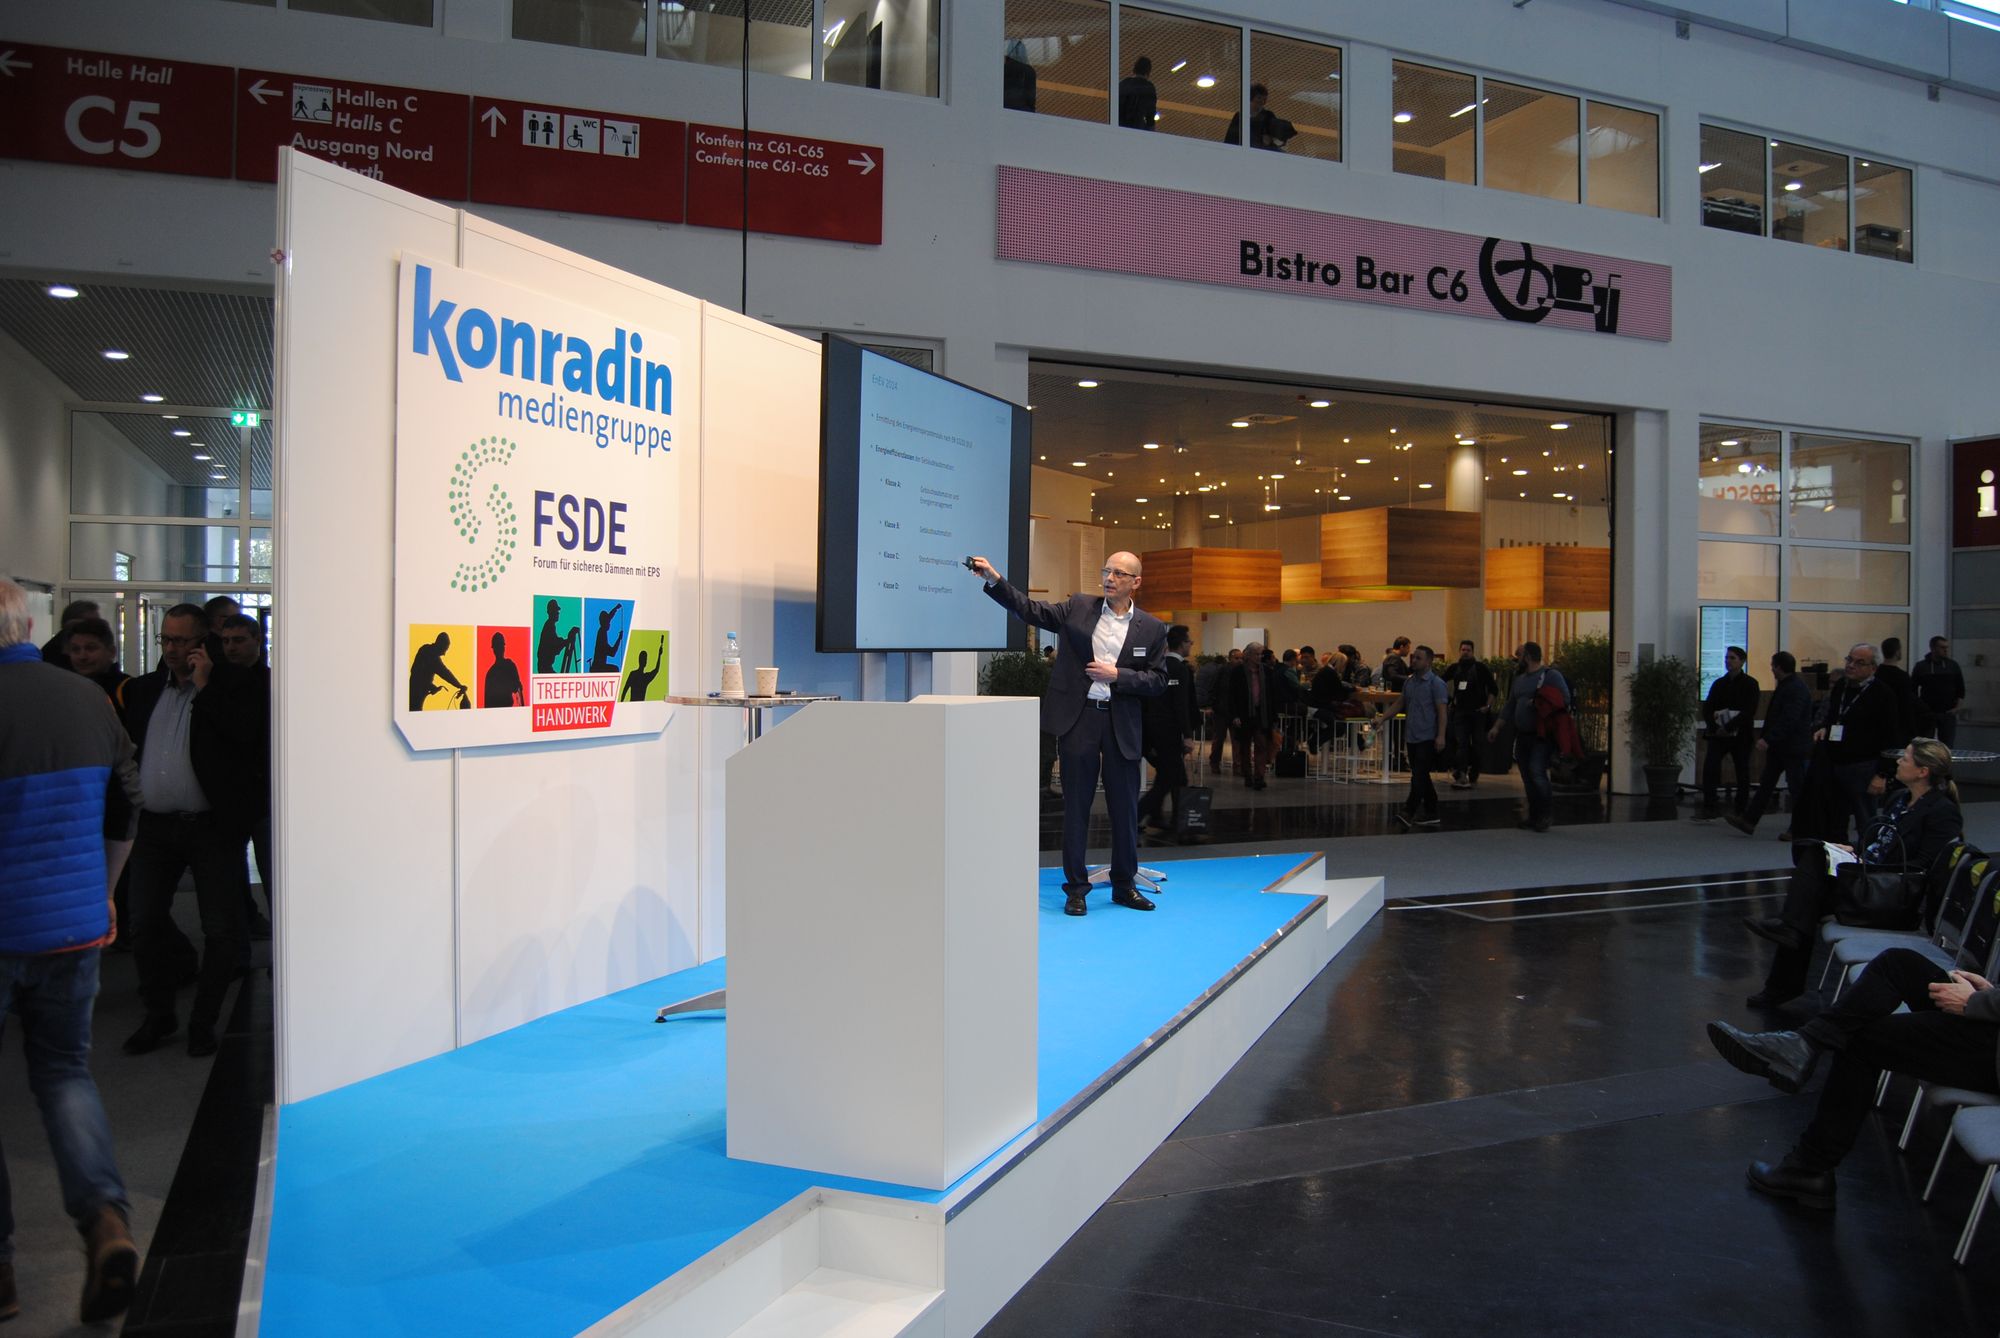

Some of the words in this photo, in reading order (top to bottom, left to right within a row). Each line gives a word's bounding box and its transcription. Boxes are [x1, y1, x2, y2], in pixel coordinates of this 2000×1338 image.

[67, 57, 123, 80] Halle
[131, 64, 172, 85] Hall
[337, 88, 398, 110] Hallen
[404, 96, 418, 113] C
[64, 95, 162, 159] C5
[336, 112, 383, 132] Halls
[389, 118, 403, 134] C
[582, 120, 598, 129] WC
[291, 132, 379, 160] Ausgang
[386, 141, 433, 162] Nord
[768, 141, 824, 159] C61-C65
[773, 159, 829, 177] C61-C65
[1240, 239, 1341, 287] Bistro
[1356, 255, 1414, 295] Bar
[1427, 266, 1469, 302] C6
[412, 263, 672, 417] konradin
[498, 391, 672, 459] mediengruppe
[533, 490, 628, 555] FSDE
[533, 556, 558, 570] Forum
[560, 558, 571, 571] für
[573, 560, 603, 574] sicheres
[605, 562, 634, 576] Dämmen
[635, 566, 646, 577] mit
[647, 566, 661, 578] EPS
[536, 680, 616, 700] TREFFPUNKT
[536, 705, 608, 728] HANDWERK
